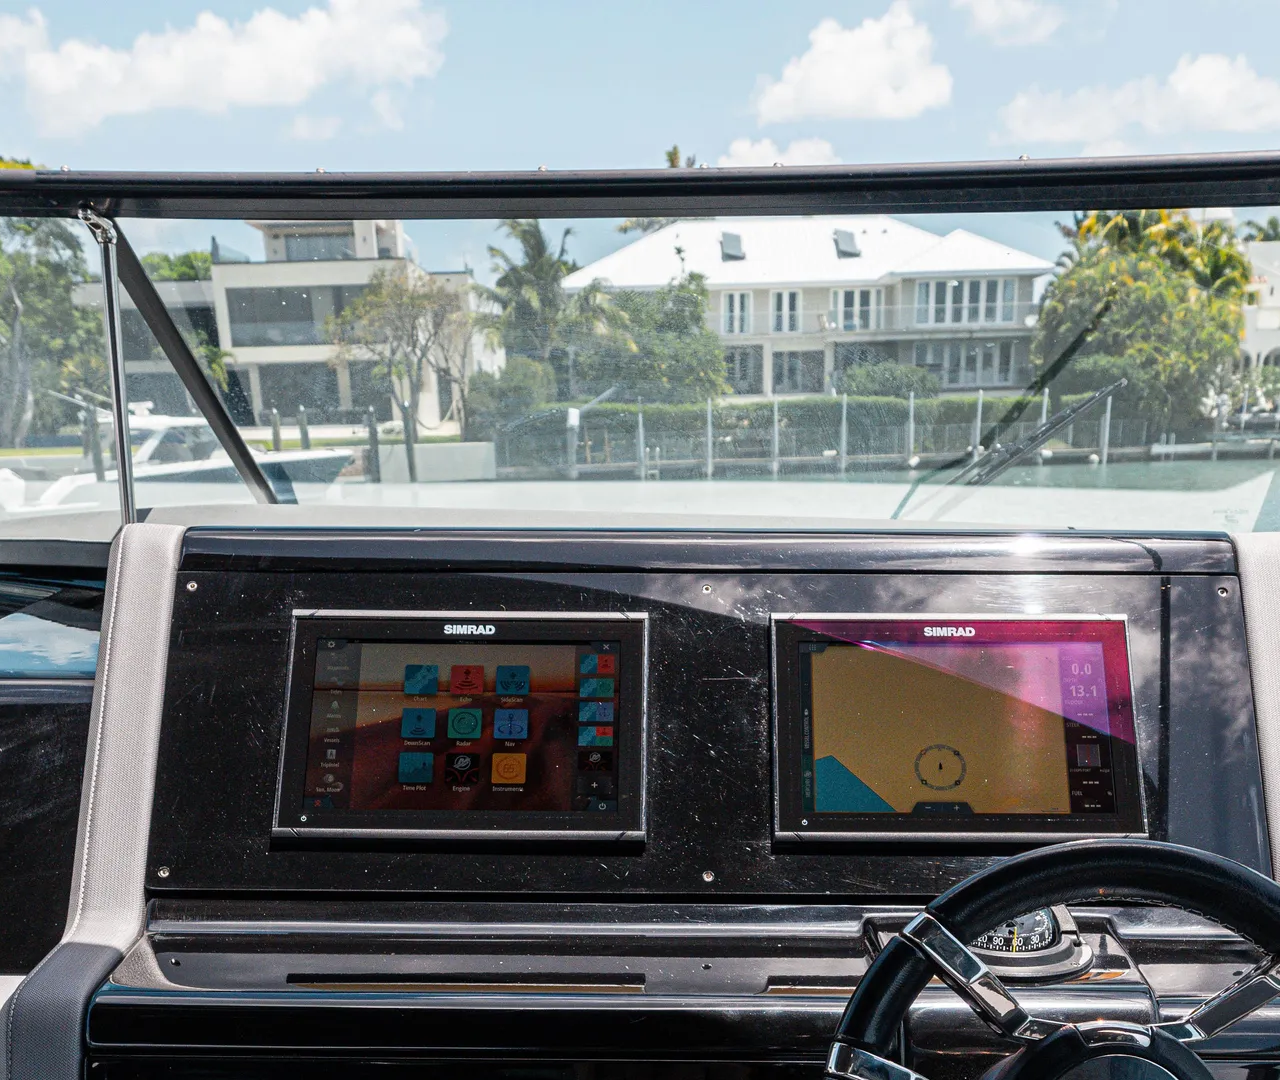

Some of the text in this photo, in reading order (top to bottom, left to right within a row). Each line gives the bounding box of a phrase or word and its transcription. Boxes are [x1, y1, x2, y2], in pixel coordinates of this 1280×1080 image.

[444, 624, 495, 635] SIMRAD
[924, 627, 975, 637] SIMRAD
[1072, 663, 1091, 674] 0.0
[1070, 686, 1097, 696] 13.1
[993, 937, 1004, 945] 90
[1031, 935, 1039, 944] 30
